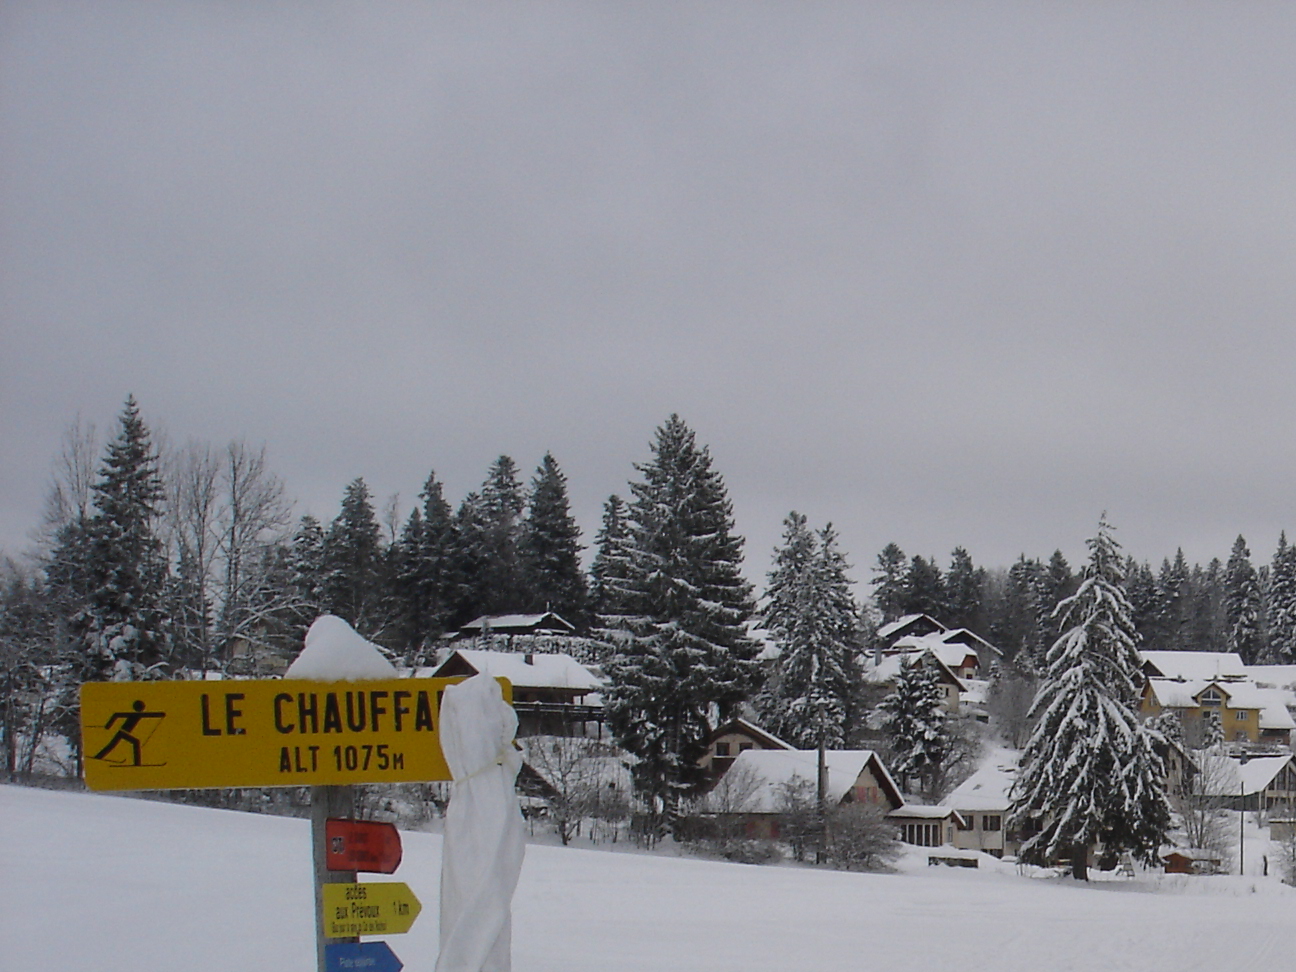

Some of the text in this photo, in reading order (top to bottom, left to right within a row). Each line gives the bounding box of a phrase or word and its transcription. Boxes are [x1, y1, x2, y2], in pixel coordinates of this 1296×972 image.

[200, 690, 445, 736] LE CHAUFFA
[279, 746, 320, 773] ALT
[398, 900, 410, 915] km
